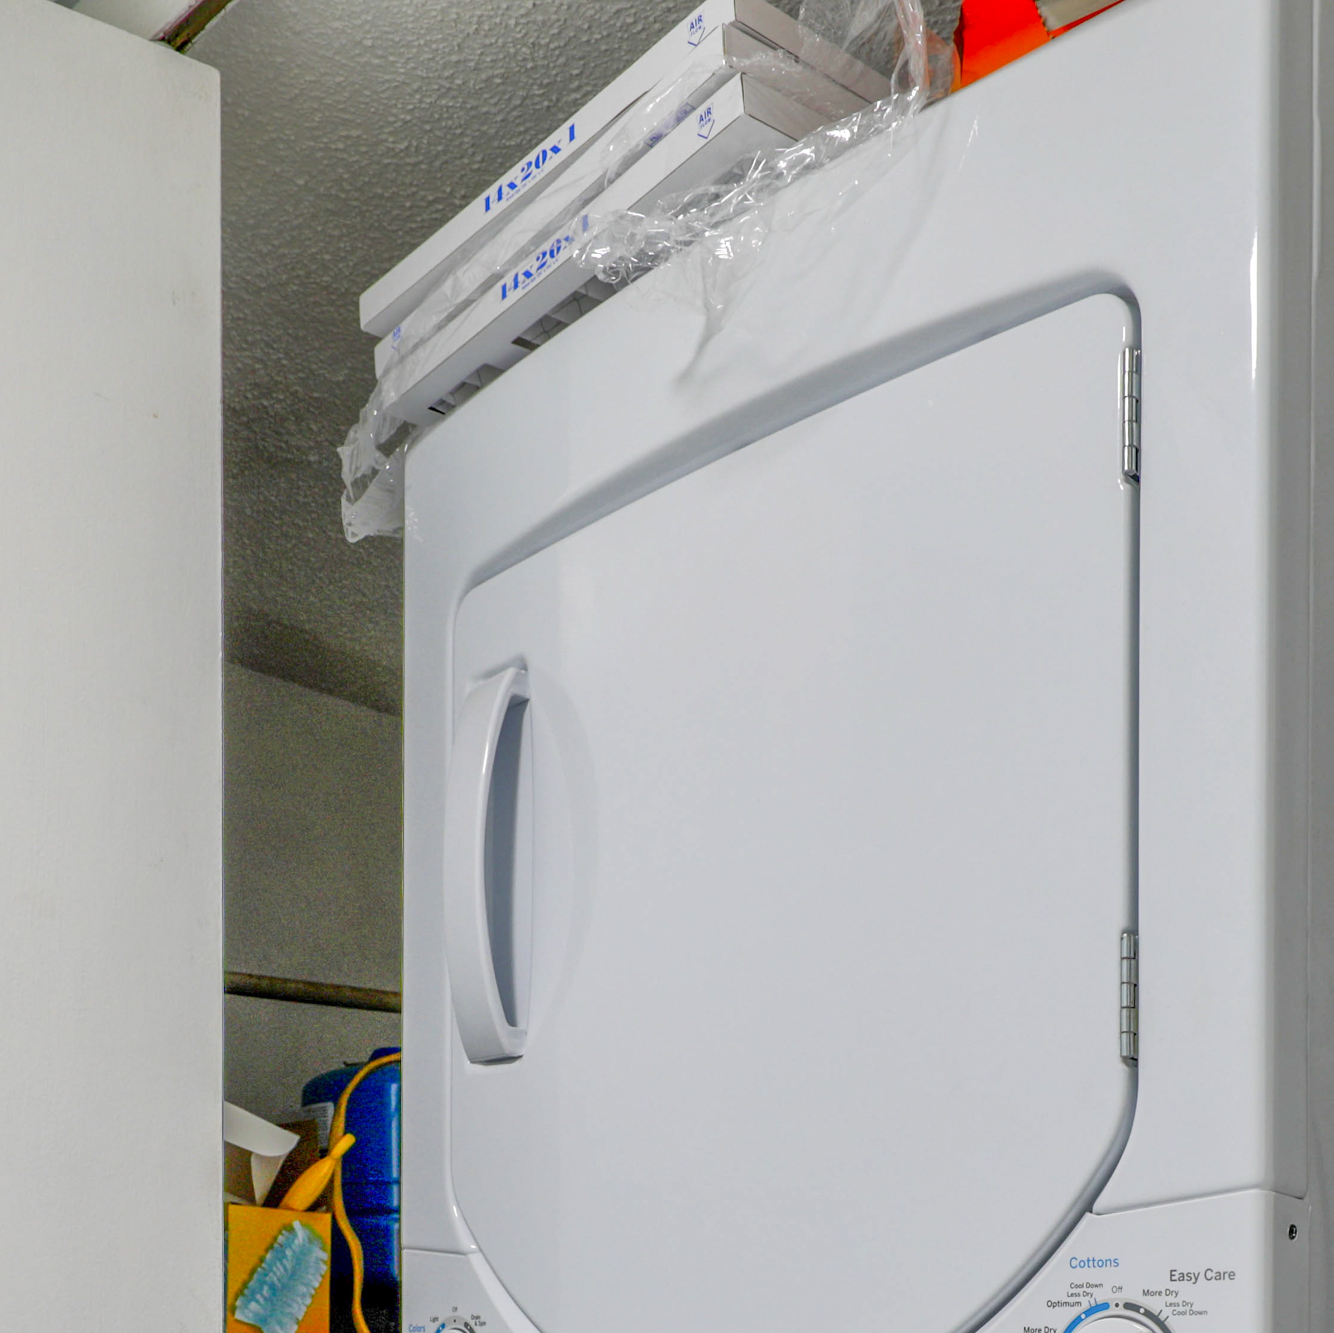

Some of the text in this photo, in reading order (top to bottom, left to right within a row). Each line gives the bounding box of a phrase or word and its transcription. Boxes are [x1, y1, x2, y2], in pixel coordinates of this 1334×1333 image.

[689, 14, 703, 32] AIR
[698, 107, 712, 124] AIR
[484, 122, 575, 214] 14x20x1
[1069, 1256, 1120, 1269] Cottons
[1169, 1268, 1236, 1284] Easy Care
[1082, 1291, 1094, 1299] Dry
[1142, 1289, 1179, 1298] More Dry
[1046, 1300, 1082, 1308] Optimum
[1181, 1301, 1194, 1309] Dry
[408, 1324, 426, 1333] Colors
[1023, 1326, 1042, 1333] More
